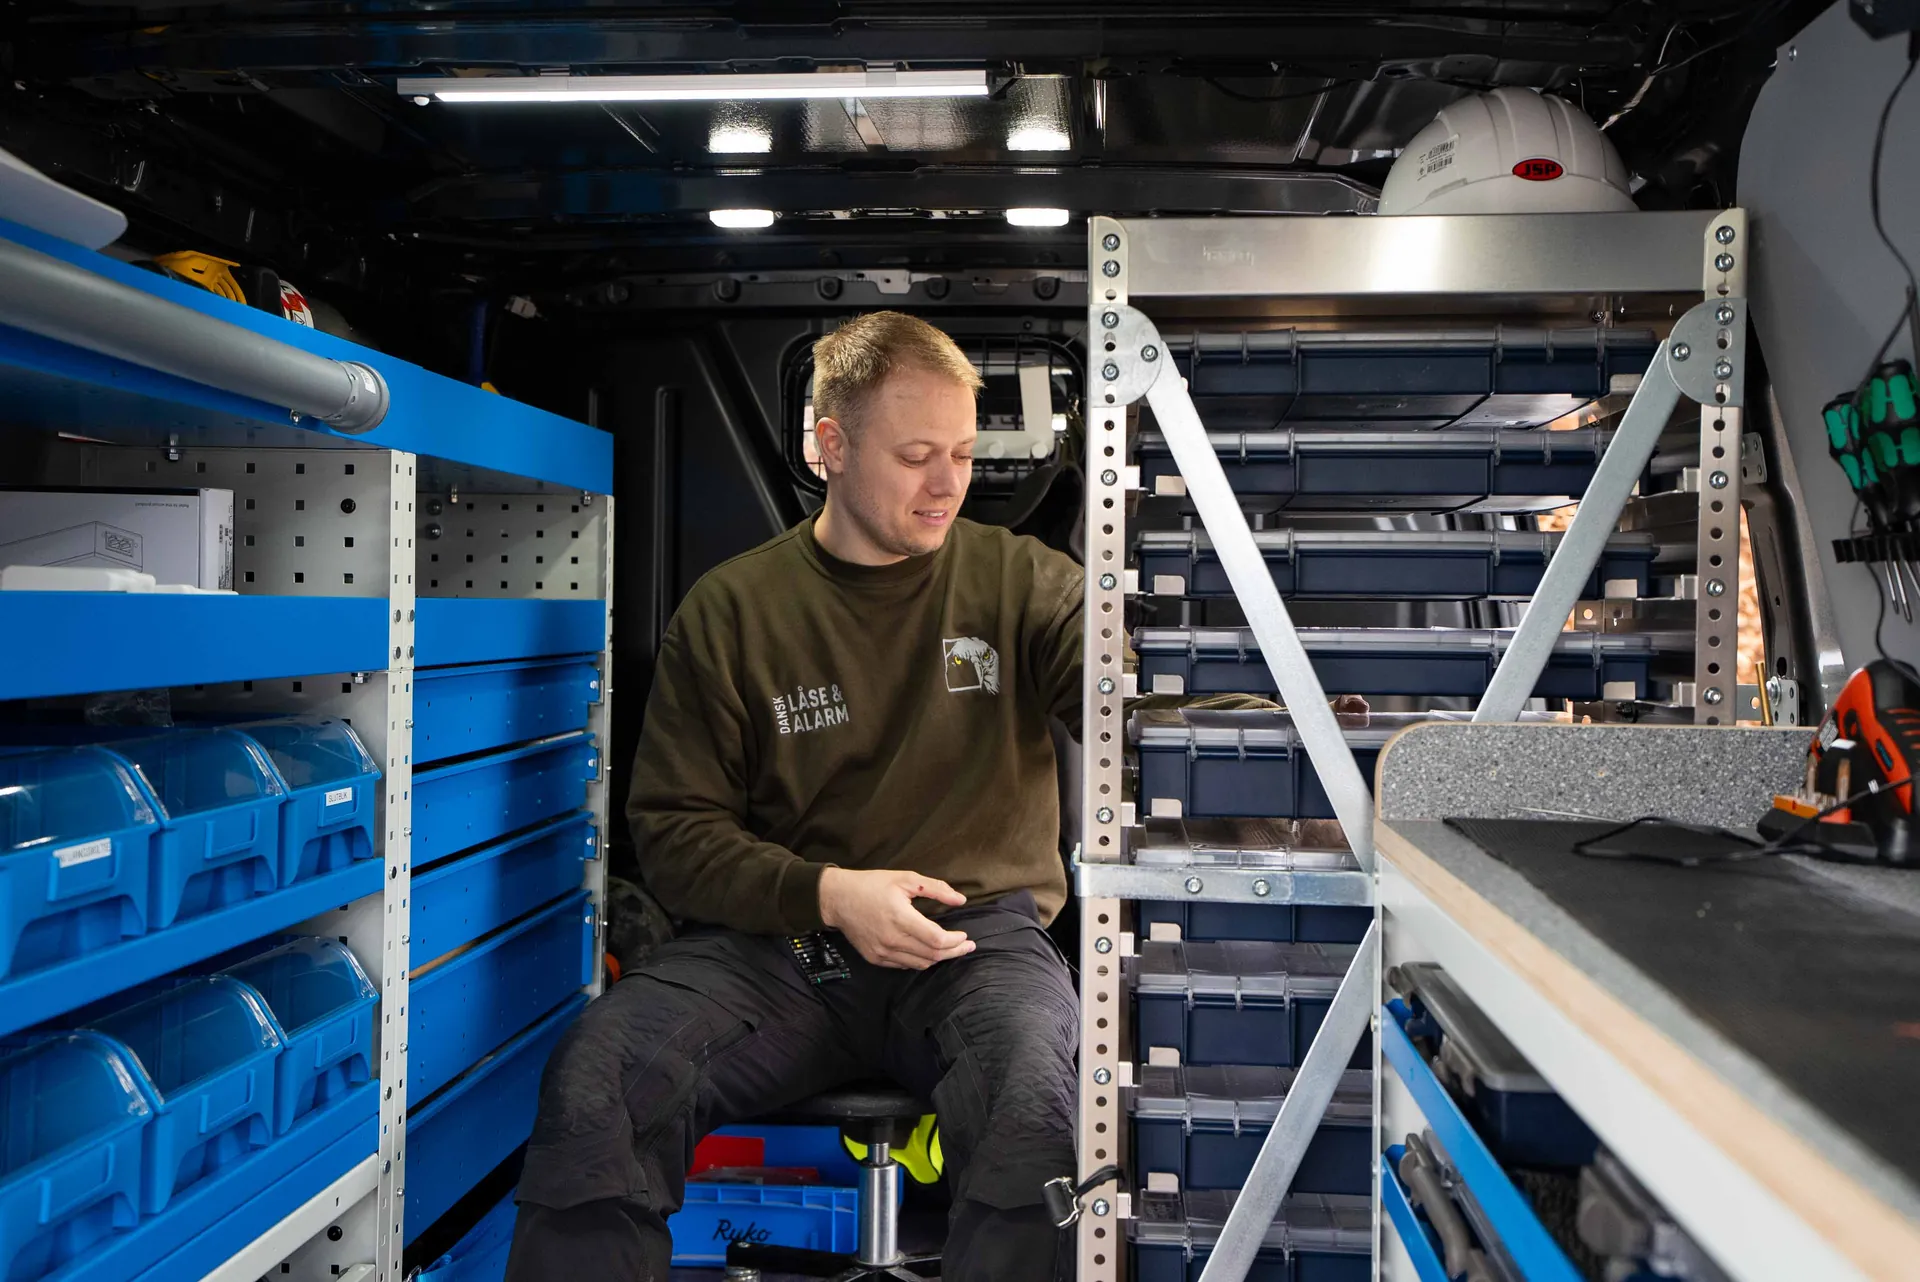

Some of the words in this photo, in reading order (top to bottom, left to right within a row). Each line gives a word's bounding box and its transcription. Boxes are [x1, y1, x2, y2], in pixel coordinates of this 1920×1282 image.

[1522, 163, 1557, 176] JSP
[788, 685, 828, 712] LÅSE
[832, 684, 843, 702] &
[772, 696, 791, 734] DANSK
[794, 703, 850, 733] ALARM
[712, 1219, 772, 1242] Ruko
